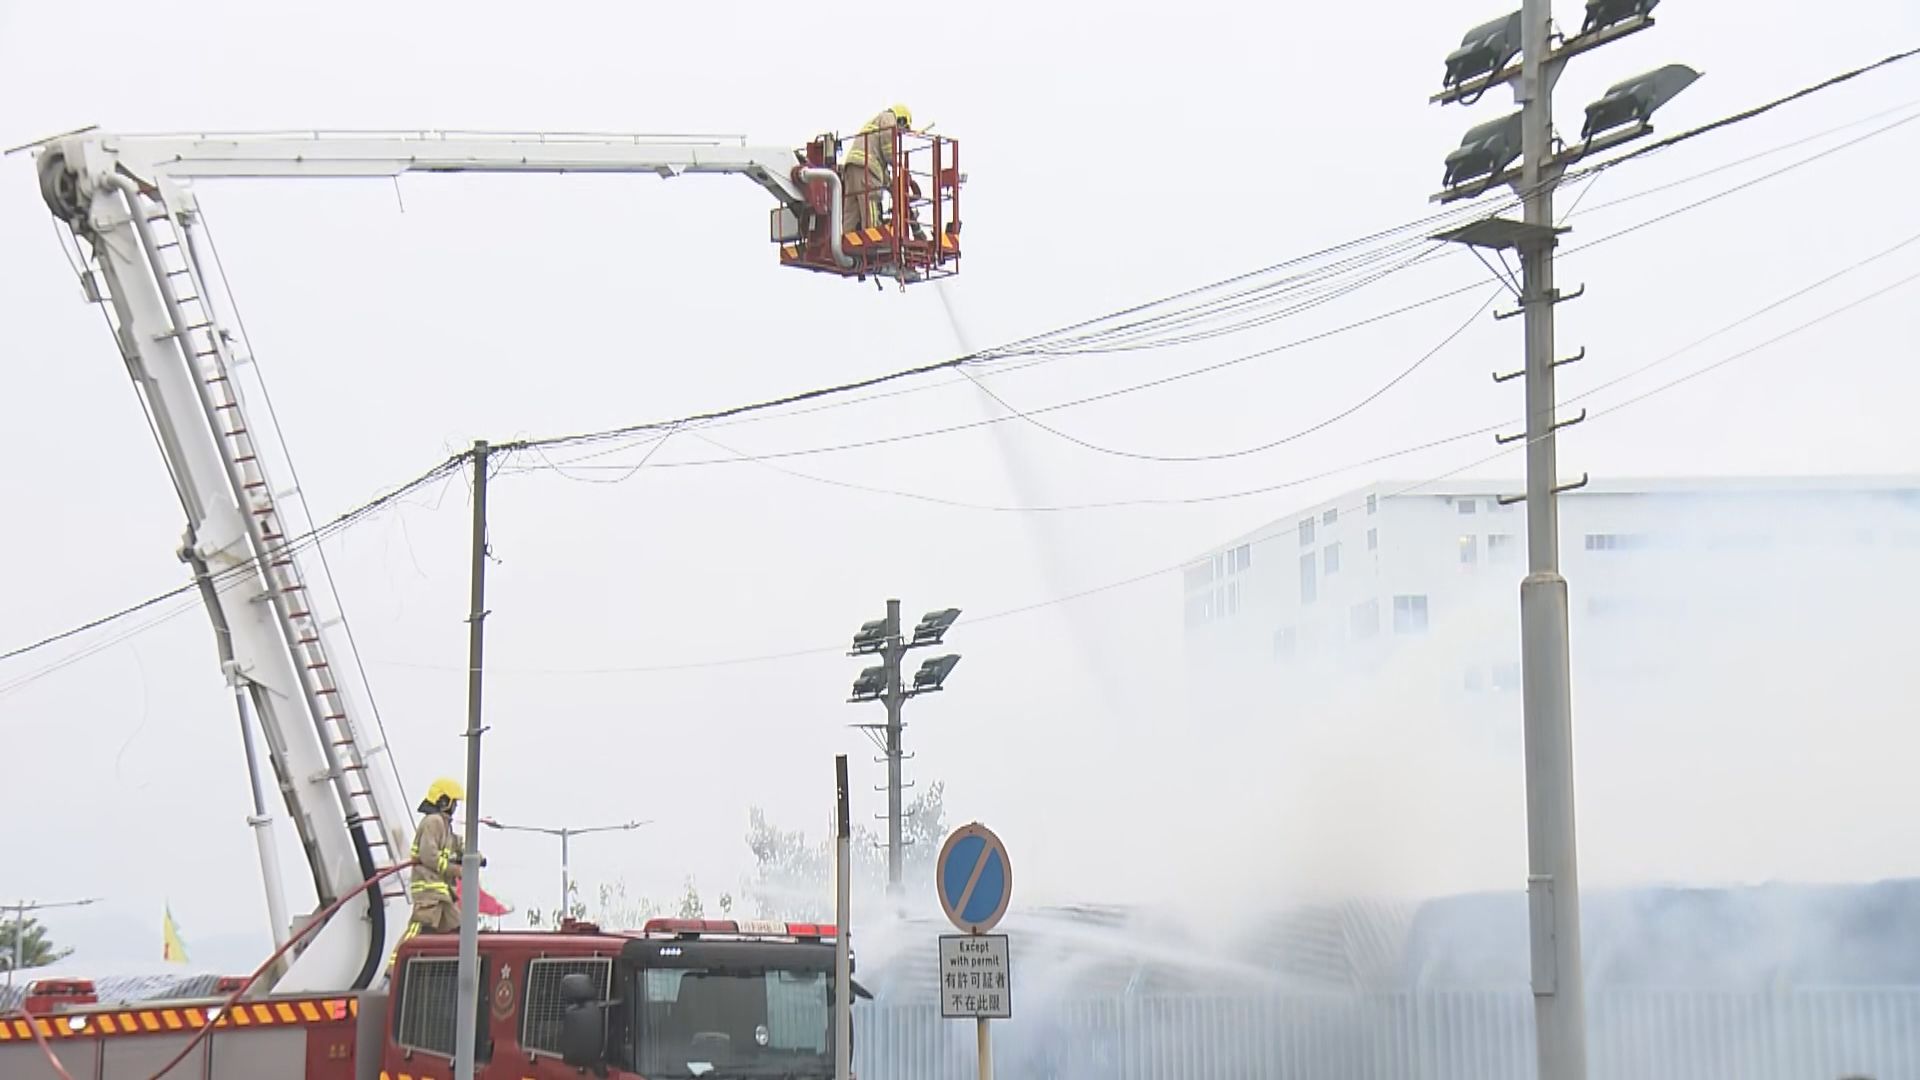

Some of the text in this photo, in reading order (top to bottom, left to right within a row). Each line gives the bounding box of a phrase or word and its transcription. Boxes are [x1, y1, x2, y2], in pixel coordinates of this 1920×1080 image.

[960, 941, 989, 953] Except
[950, 955, 1000, 967] with permit
[952, 994, 1000, 1011] 不在此限
